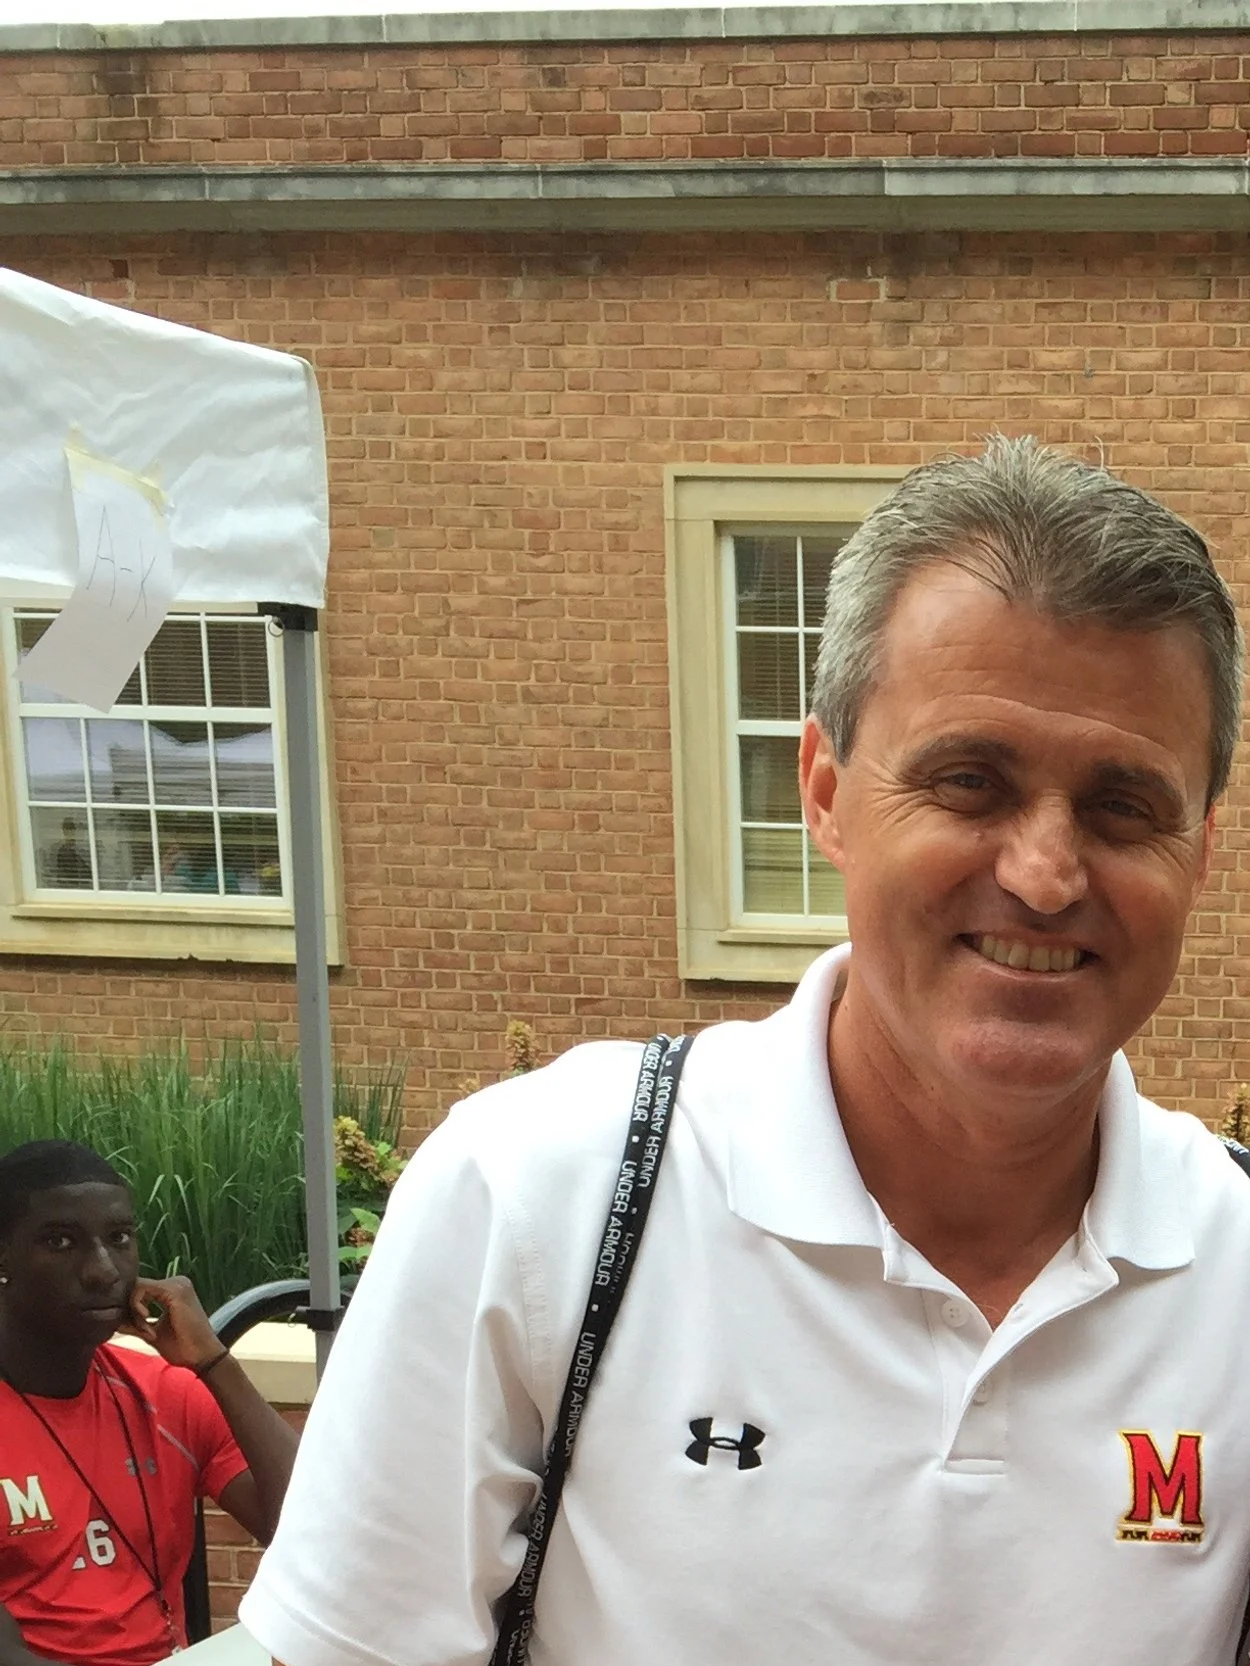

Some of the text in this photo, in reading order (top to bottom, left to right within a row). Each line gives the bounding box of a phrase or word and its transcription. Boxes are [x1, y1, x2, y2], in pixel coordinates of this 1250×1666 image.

[632, 1070, 656, 1122] ARMOUR
[637, 1075, 674, 1188] UNDER ARMOUR
[612, 1160, 638, 1214] UNDER
[595, 1215, 624, 1287] ARMOUR
[573, 1332, 597, 1389] UNDER
[0, 1475, 54, 1527] M
[1116, 1429, 1205, 1527] M
